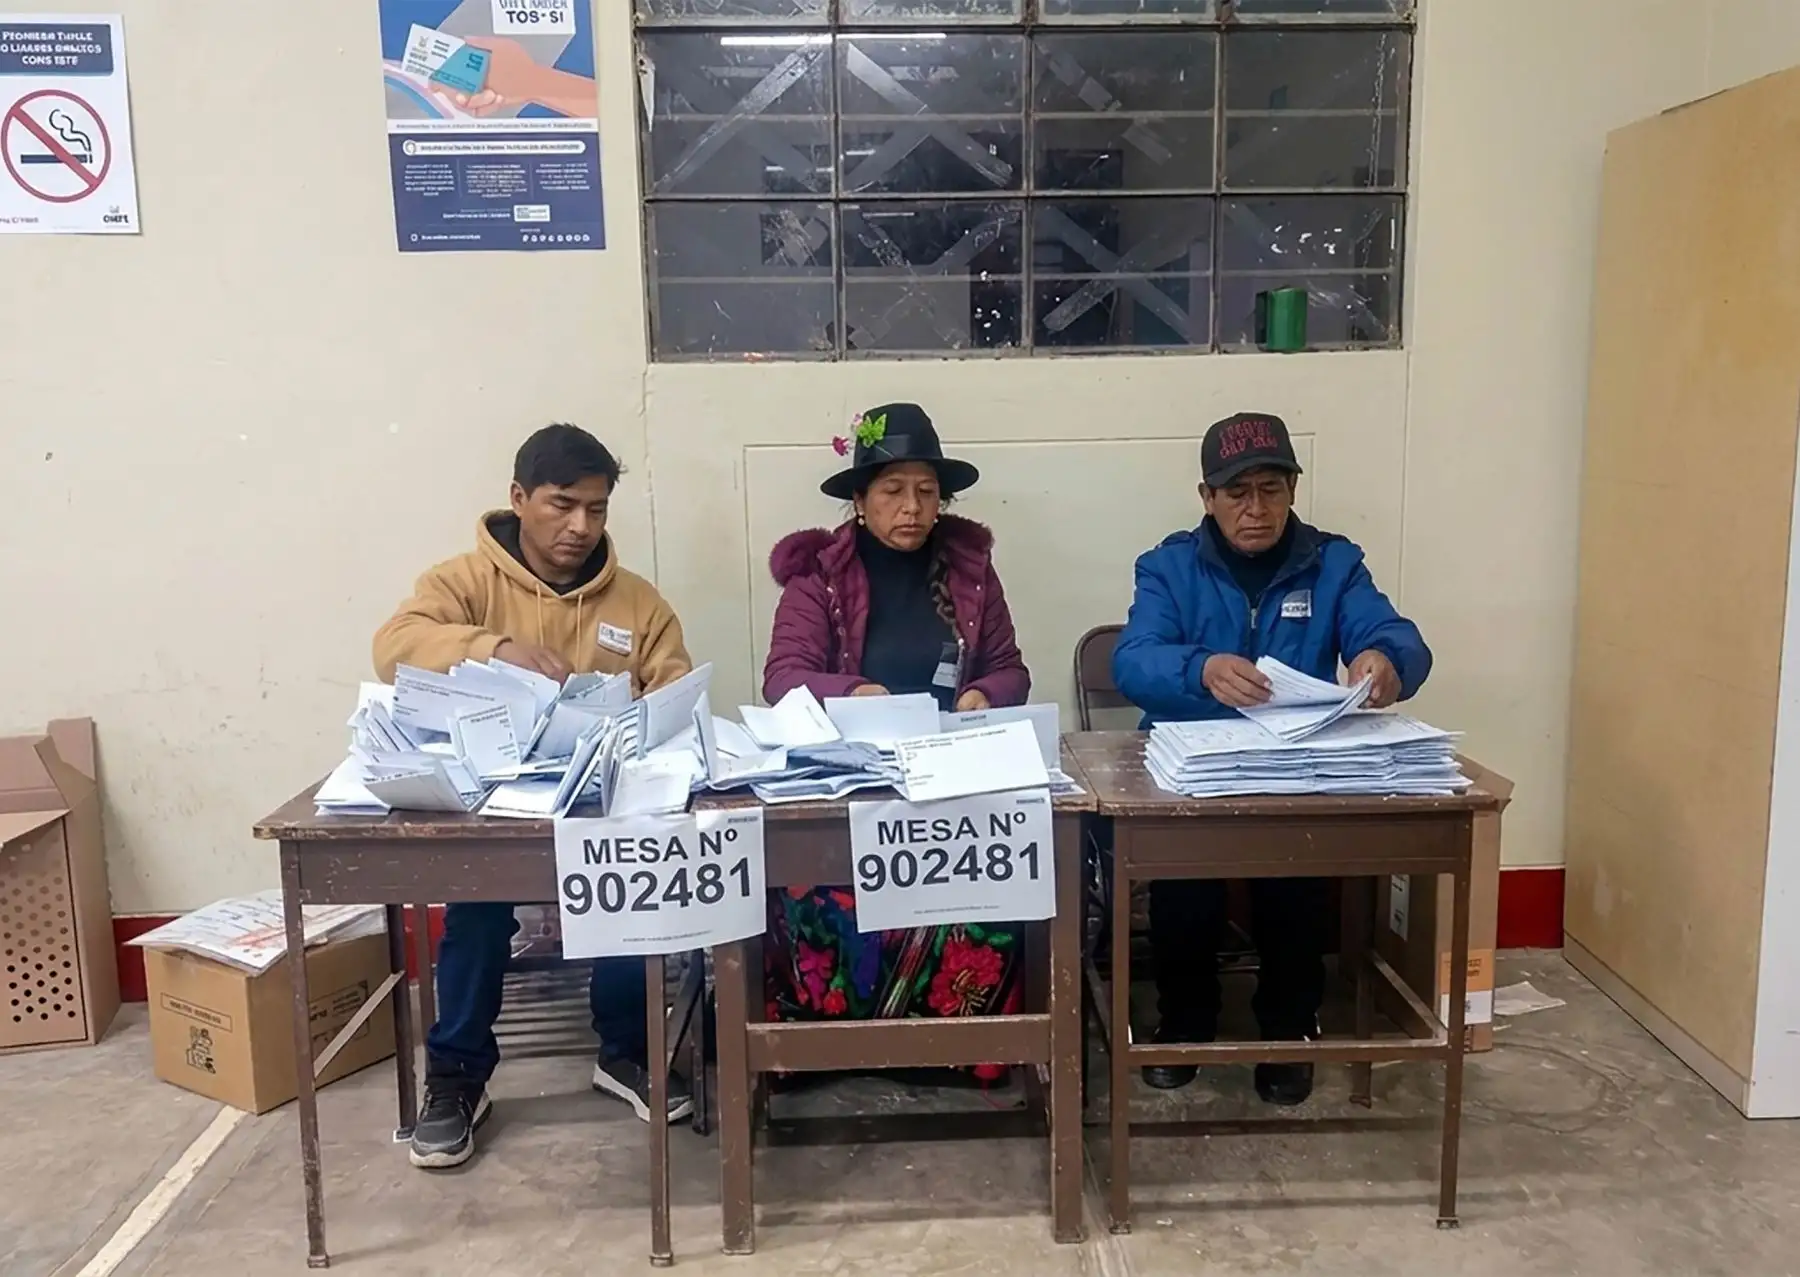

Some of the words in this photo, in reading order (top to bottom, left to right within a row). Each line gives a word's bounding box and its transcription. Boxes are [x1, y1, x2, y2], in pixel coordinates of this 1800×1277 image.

[582, 836, 689, 865] MESA
[877, 816, 980, 846] MESA
[562, 857, 750, 915] 902481
[857, 842, 1039, 892] 902481
